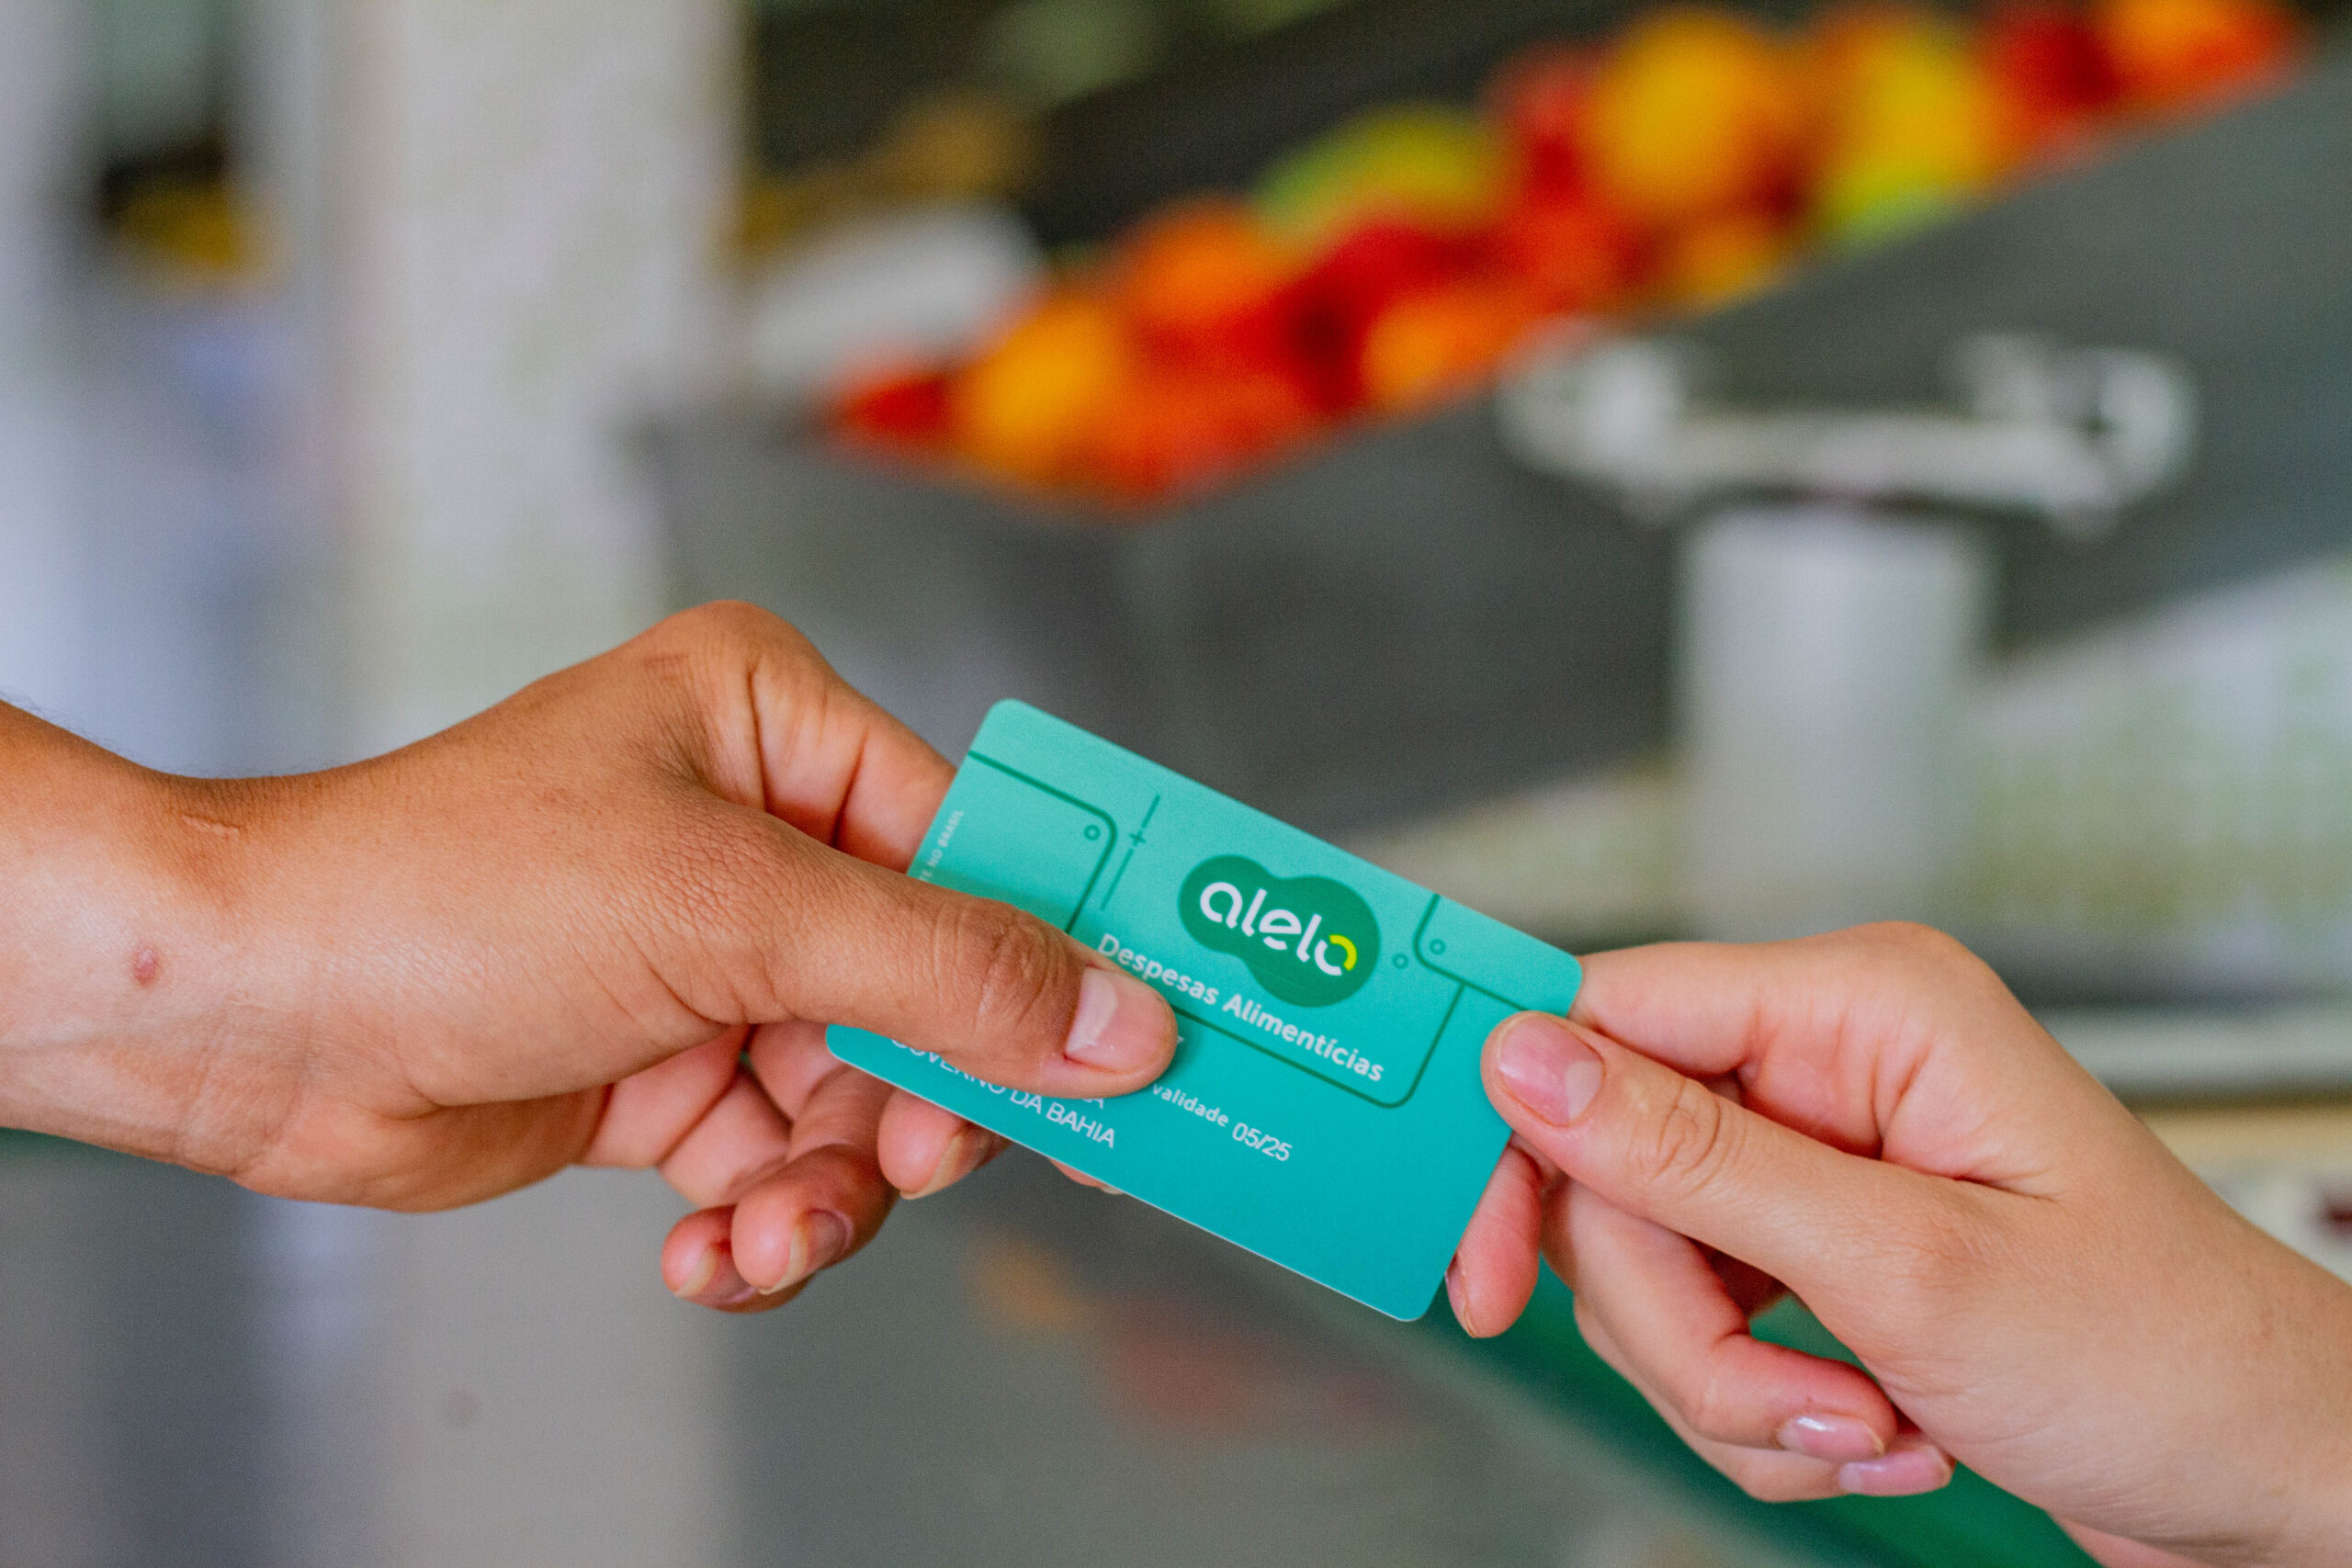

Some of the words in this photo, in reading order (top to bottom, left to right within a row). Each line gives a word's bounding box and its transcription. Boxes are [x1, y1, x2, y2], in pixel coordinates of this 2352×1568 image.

[938, 810, 964, 847] BRASIL
[1200, 882, 1357, 976] alelo
[1098, 933, 1219, 1005] Despesas
[1222, 994, 1384, 1082] Alimentícias
[1010, 1089, 1042, 1114] DA
[1046, 1101, 1114, 1148] BAHIA
[1153, 1084, 1229, 1127] validade
[1232, 1122, 1293, 1161] 05/25
